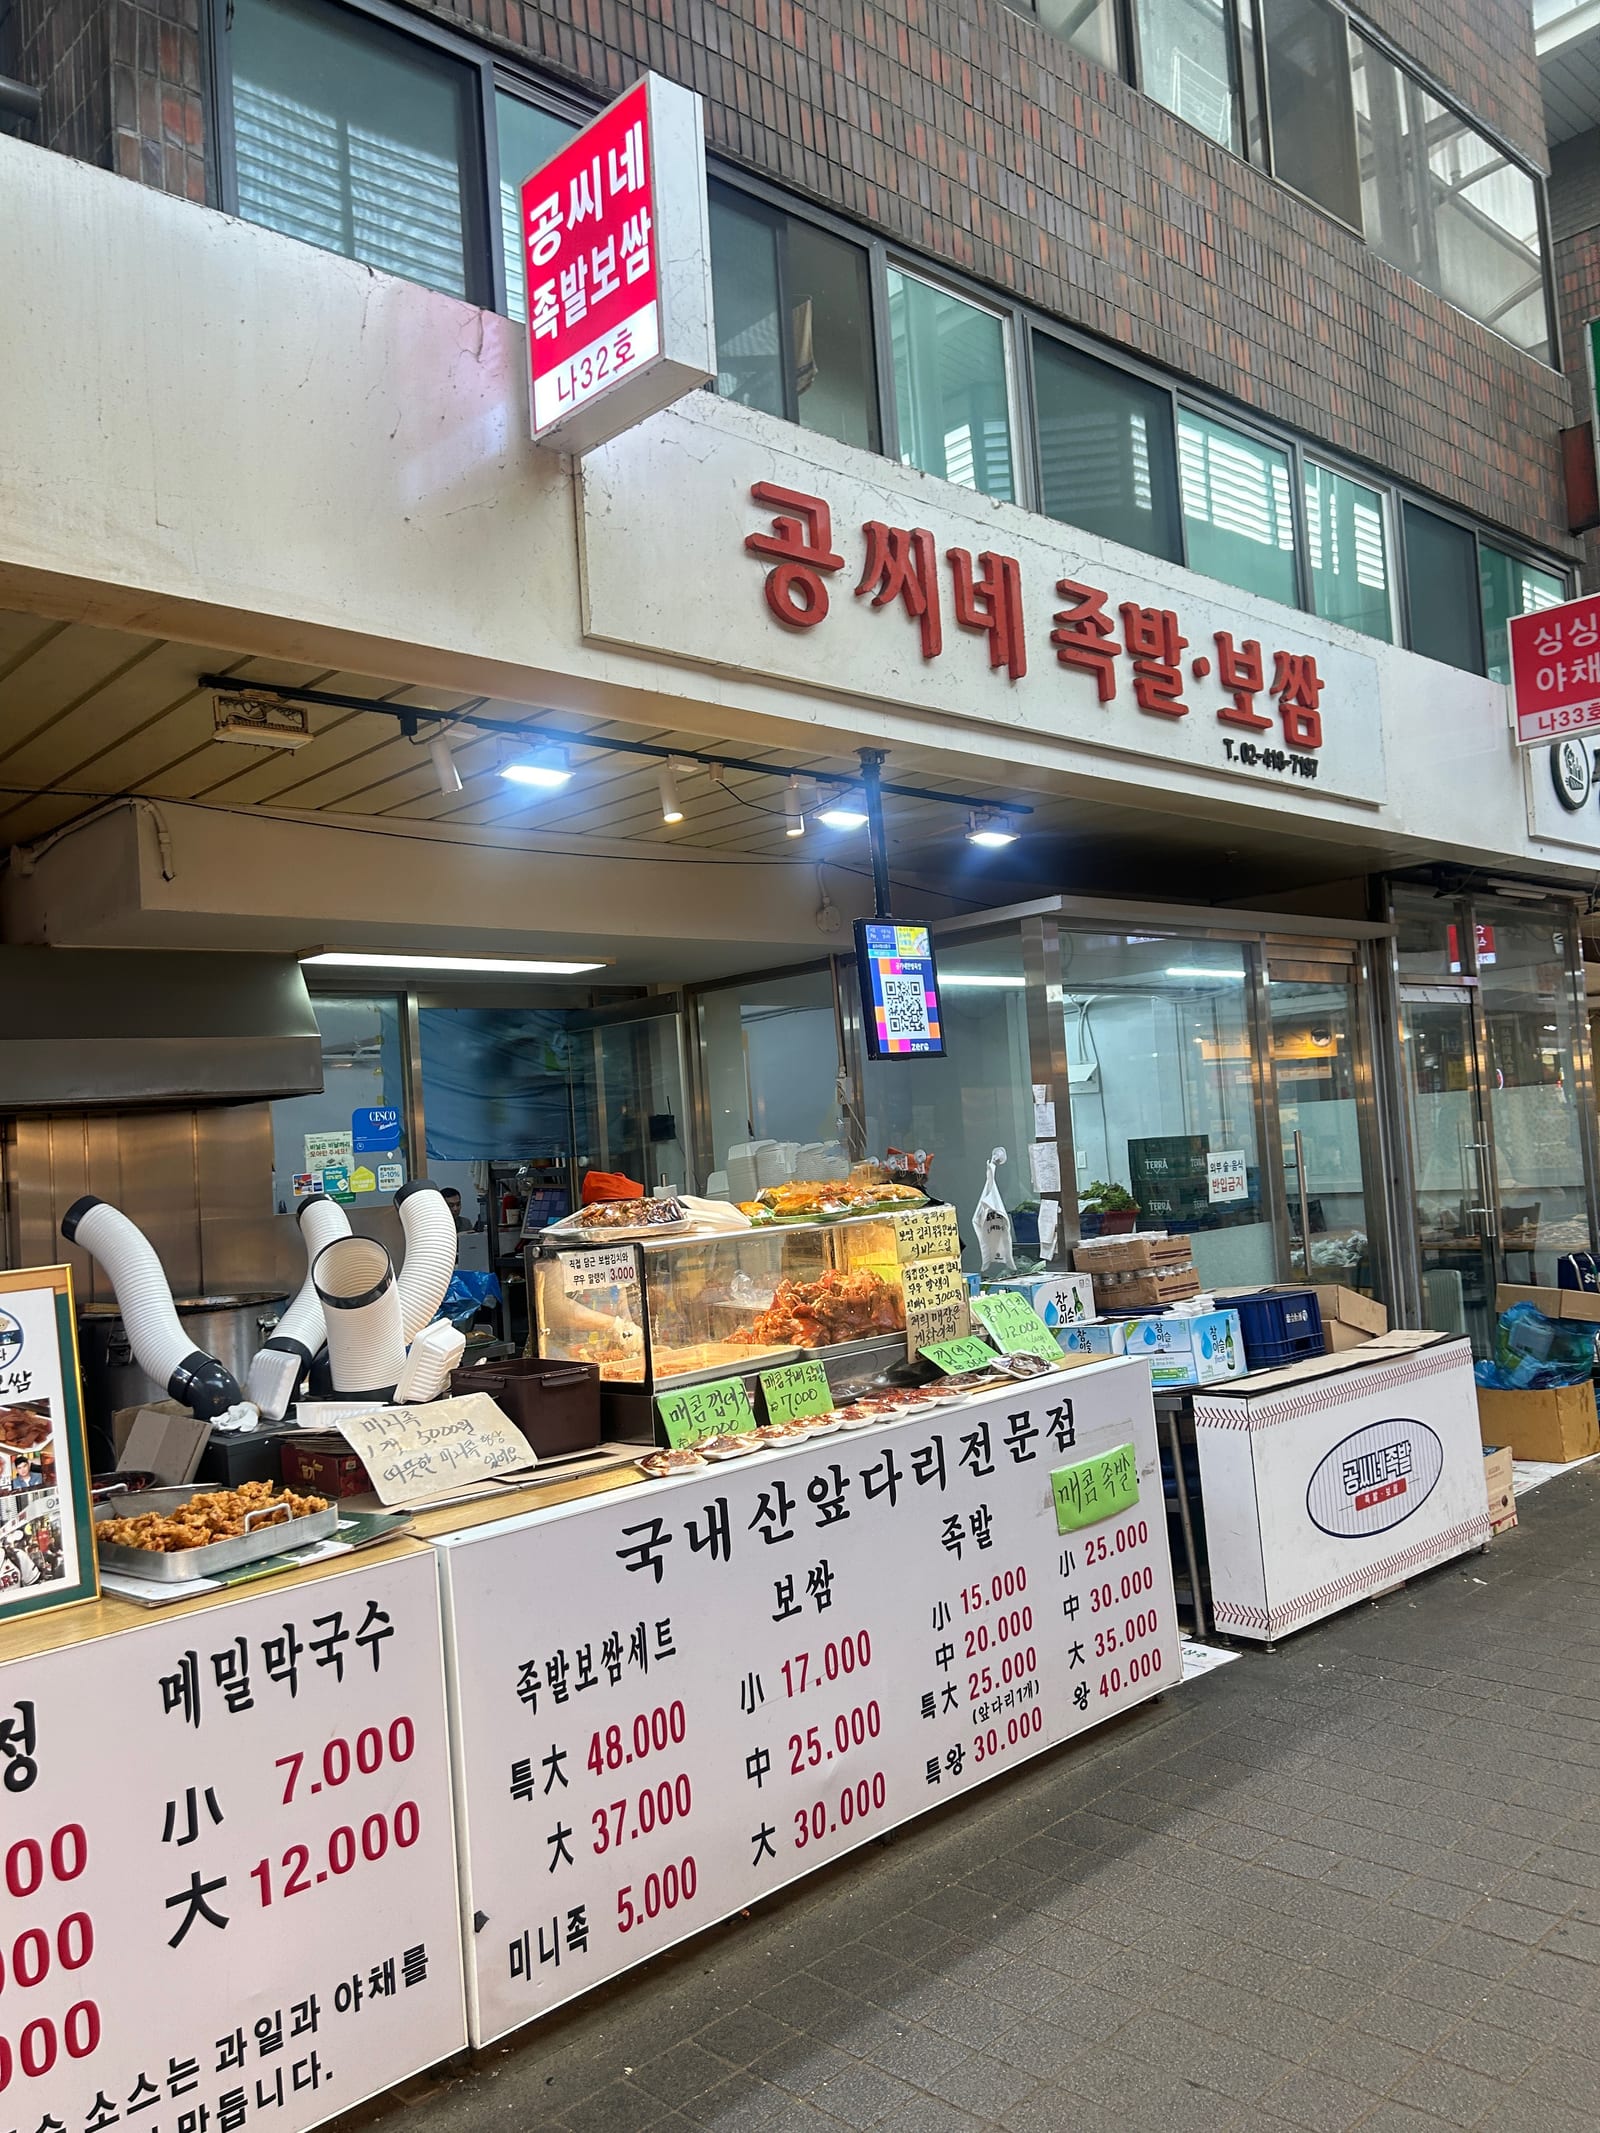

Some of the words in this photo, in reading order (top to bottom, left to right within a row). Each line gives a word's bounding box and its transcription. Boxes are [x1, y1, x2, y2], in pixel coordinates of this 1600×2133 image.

[528, 120, 645, 266] 공씨네
[531, 206, 651, 340] 족발보쌈
[557, 328, 635, 402] 나32호
[745, 481, 1028, 681] 공씨네
[1533, 612, 1600, 656] 싱싱
[369, 1110, 396, 1122] CESCO
[1145, 1158, 1169, 1170] TERRA
[1210, 1163, 1222, 1173] 외부
[1212, 1175, 1244, 1194] 반입금지
[1149, 1200, 1172, 1211] TERRA
[569, 1258, 581, 1270] 직접
[583, 1257, 596, 1268] 담근
[573, 1274, 586, 1286] 무우
[588, 1272, 606, 1284] 말랭이
[360, 1410, 421, 1435] 미니족
[440, 1439, 484, 1469] 미니족
[1342, 1439, 1413, 1496] 공씨네족발
[941, 1503, 993, 1561] 족발
[1059, 1550, 1076, 1578] 小
[1084, 1520, 1148, 1566] 25.000
[772, 1558, 835, 1623] 보쌈
[931, 1601, 951, 1632] 小
[960, 1566, 1027, 1615] 15.000
[1063, 1594, 1080, 1622] 中
[1090, 1566, 1154, 1613] 30.000
[159, 1600, 395, 1729] 메밀막국수
[516, 1618, 677, 1716] 족발보쌈세트
[935, 1642, 955, 1672] 中
[964, 1606, 1033, 1658] 20.000
[1067, 1640, 1086, 1669] 大
[1095, 1608, 1158, 1658] 35.000
[740, 1672, 765, 1715] 小
[781, 1629, 871, 1698] 17.000
[968, 1646, 1037, 1701] 25.000
[1072, 1681, 1090, 1711] 왕
[1098, 1648, 1162, 1698] 40.000
[587, 1700, 686, 1776] 48.000
[745, 1747, 771, 1789] 中
[788, 1700, 881, 1776] 25.000
[973, 1706, 1043, 1763] 30.000
[161, 1786, 225, 1847] 小
[275, 1716, 415, 1806] 7.000
[547, 1821, 574, 1874] 大
[592, 1773, 692, 1855] 37.000
[751, 1822, 777, 1868] 大
[793, 1772, 886, 1849] 30.000
[165, 1870, 230, 1949] 大
[250, 1801, 421, 1908] 12.000
[509, 1905, 589, 1982] 미니족
[617, 1855, 697, 1934] 5.000
[85, 2056, 200, 2133] 소스는
[215, 1994, 321, 2073] 과일과
[334, 1943, 429, 2014] 야채를
